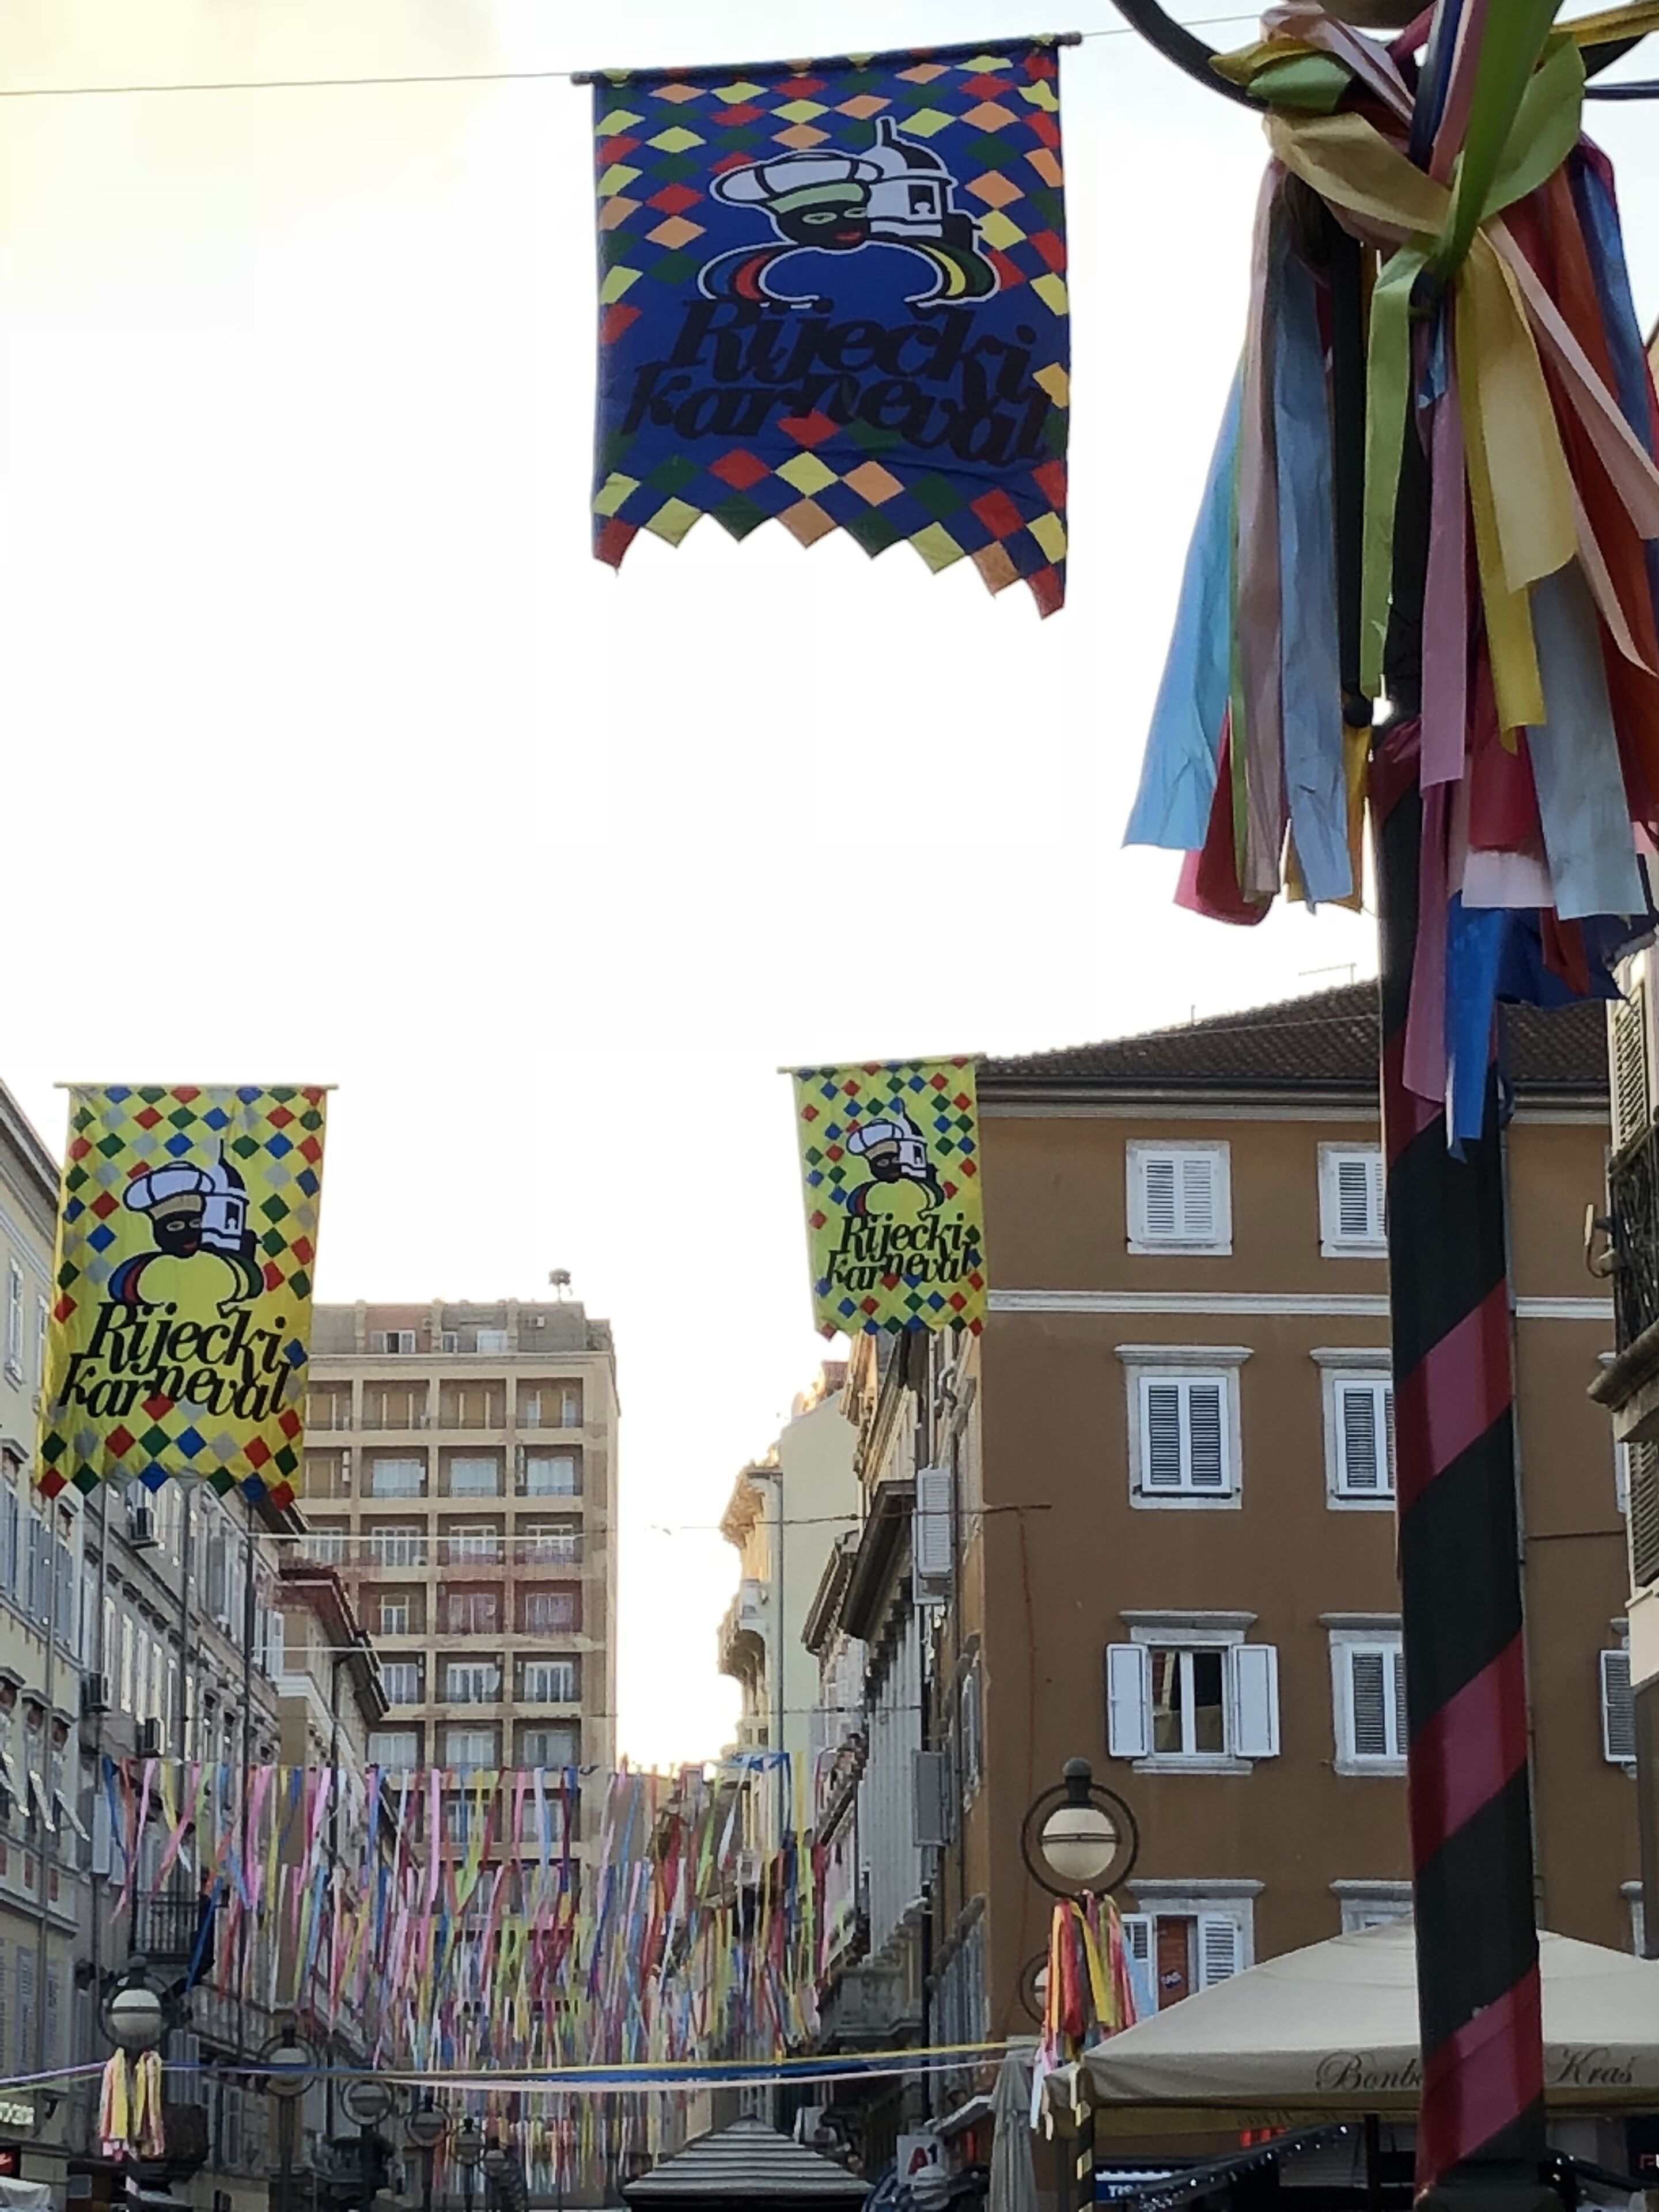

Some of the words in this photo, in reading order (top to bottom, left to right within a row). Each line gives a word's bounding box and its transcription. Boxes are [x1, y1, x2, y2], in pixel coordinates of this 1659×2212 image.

[668, 298, 1036, 416] Rijecki
[839, 1212, 964, 1263] Rijecki
[86, 1301, 286, 1384] Rijecki
